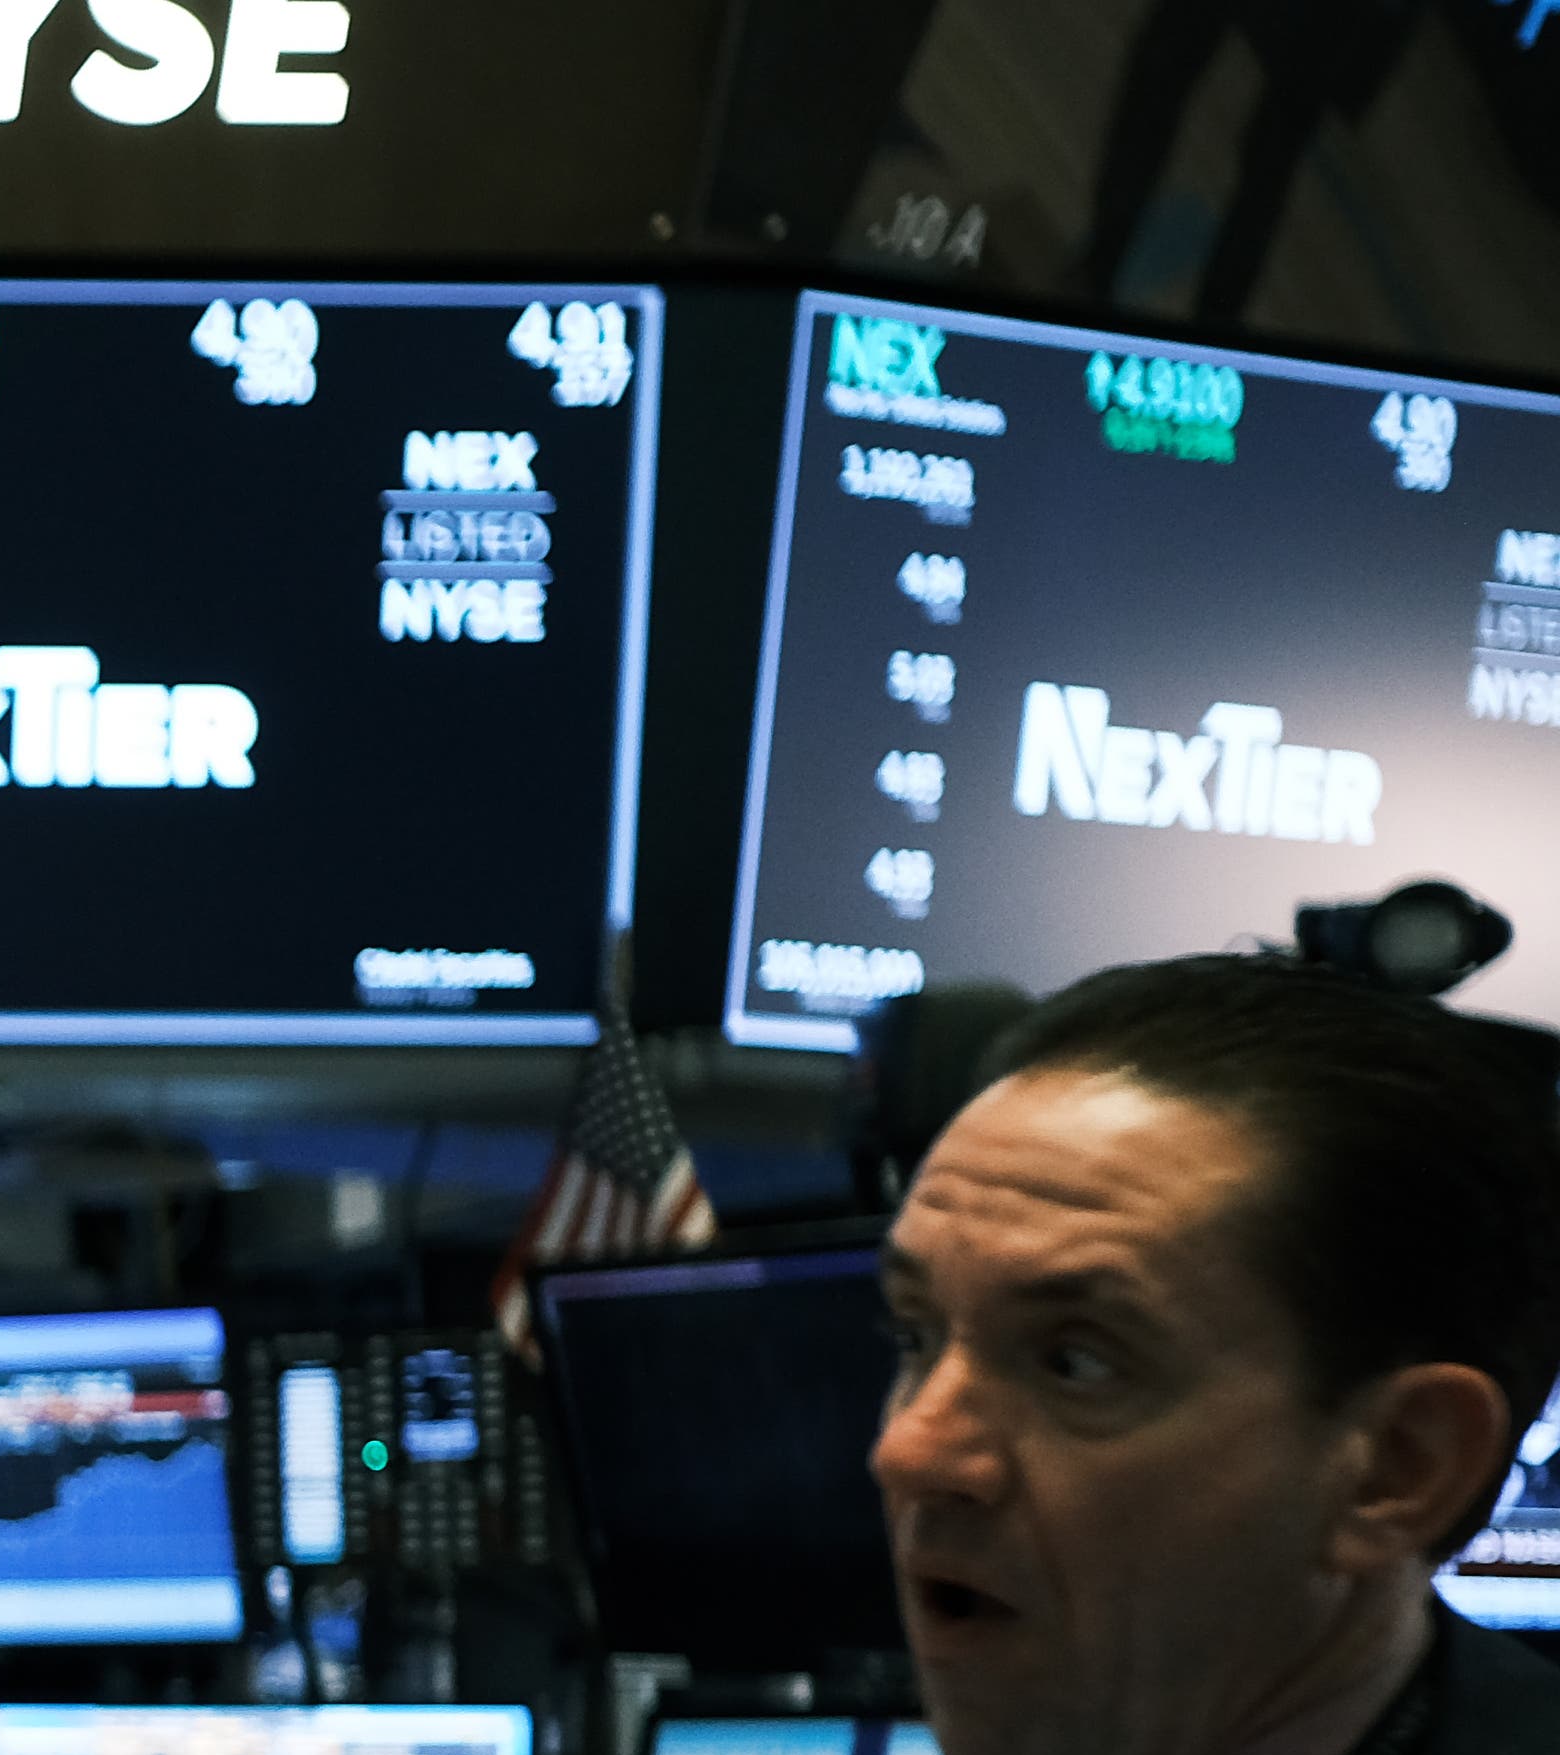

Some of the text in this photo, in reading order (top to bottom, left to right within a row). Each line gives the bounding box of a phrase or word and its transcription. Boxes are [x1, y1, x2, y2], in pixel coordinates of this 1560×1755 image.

[828, 312, 949, 399] NEX
[402, 431, 539, 493] NEX
[1496, 528, 1560, 588] NE
[380, 578, 547, 642] NYSE
